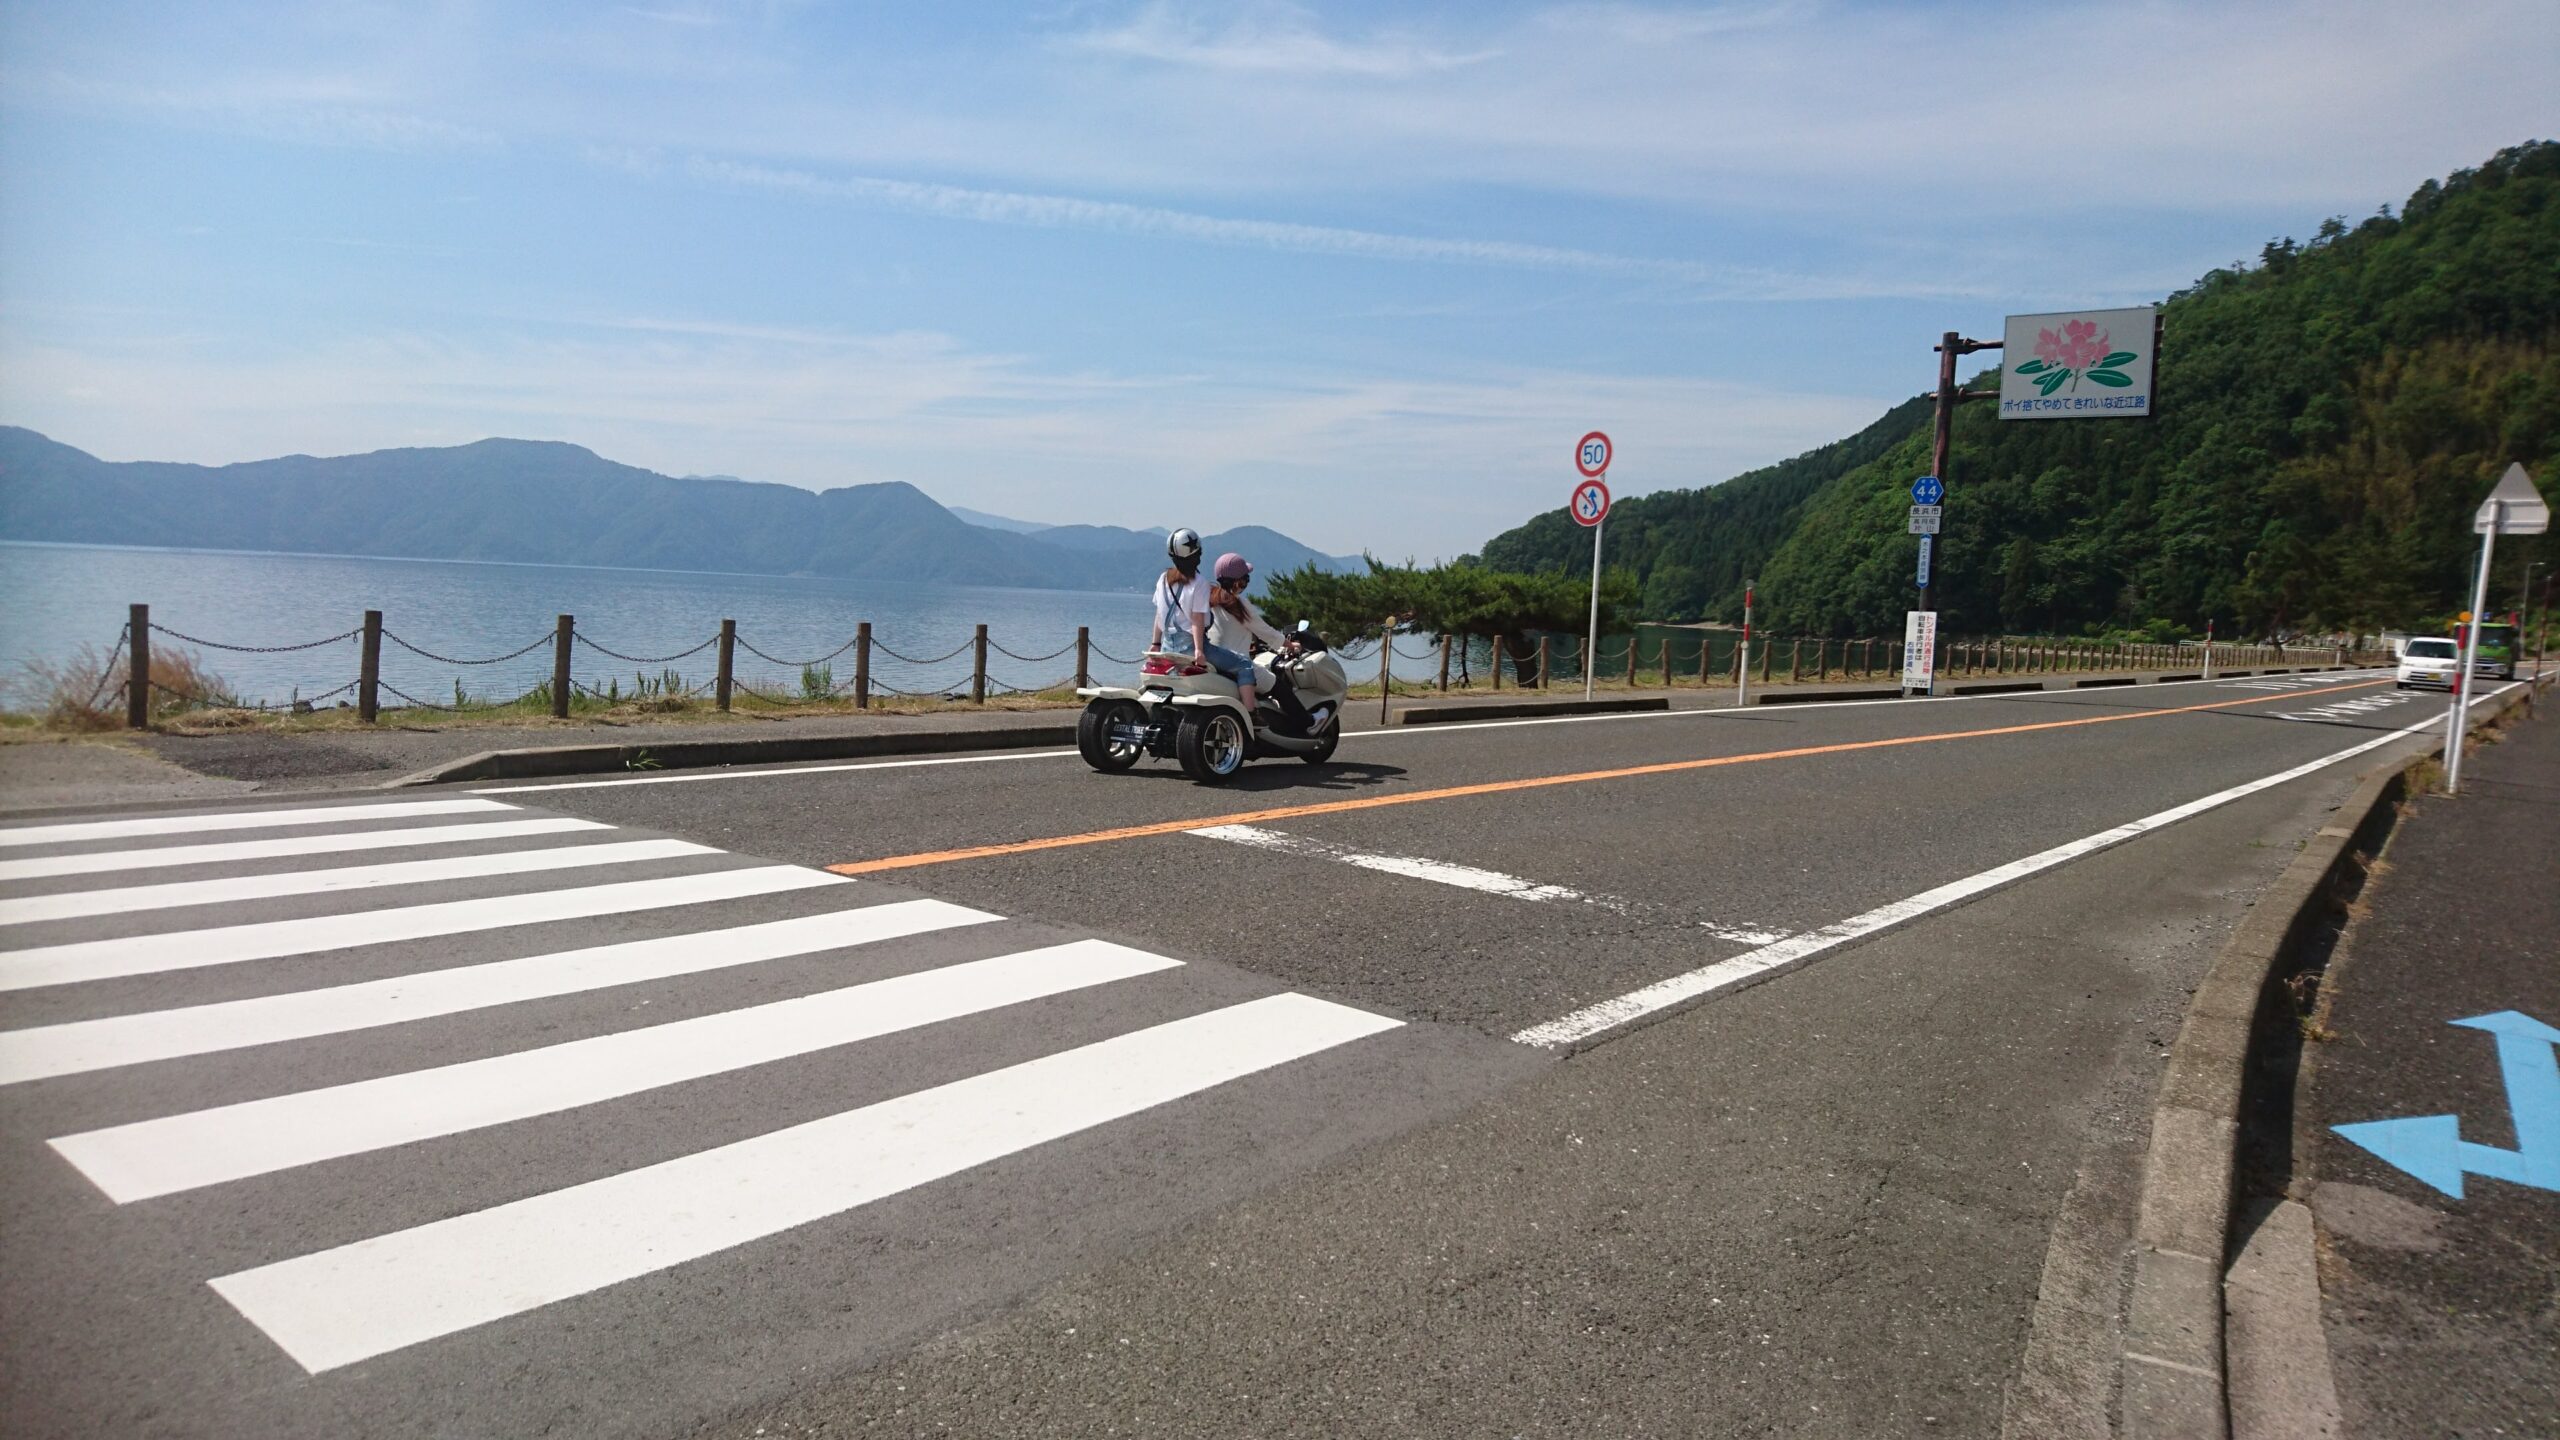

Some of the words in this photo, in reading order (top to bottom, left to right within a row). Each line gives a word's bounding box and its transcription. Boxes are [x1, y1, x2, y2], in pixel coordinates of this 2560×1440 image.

[2074, 395, 2145, 409] きれいな近江路
[1583, 444, 1604, 465] 50
[1916, 485, 1937, 496] 44
[1912, 507, 1939, 515] 長浜市
